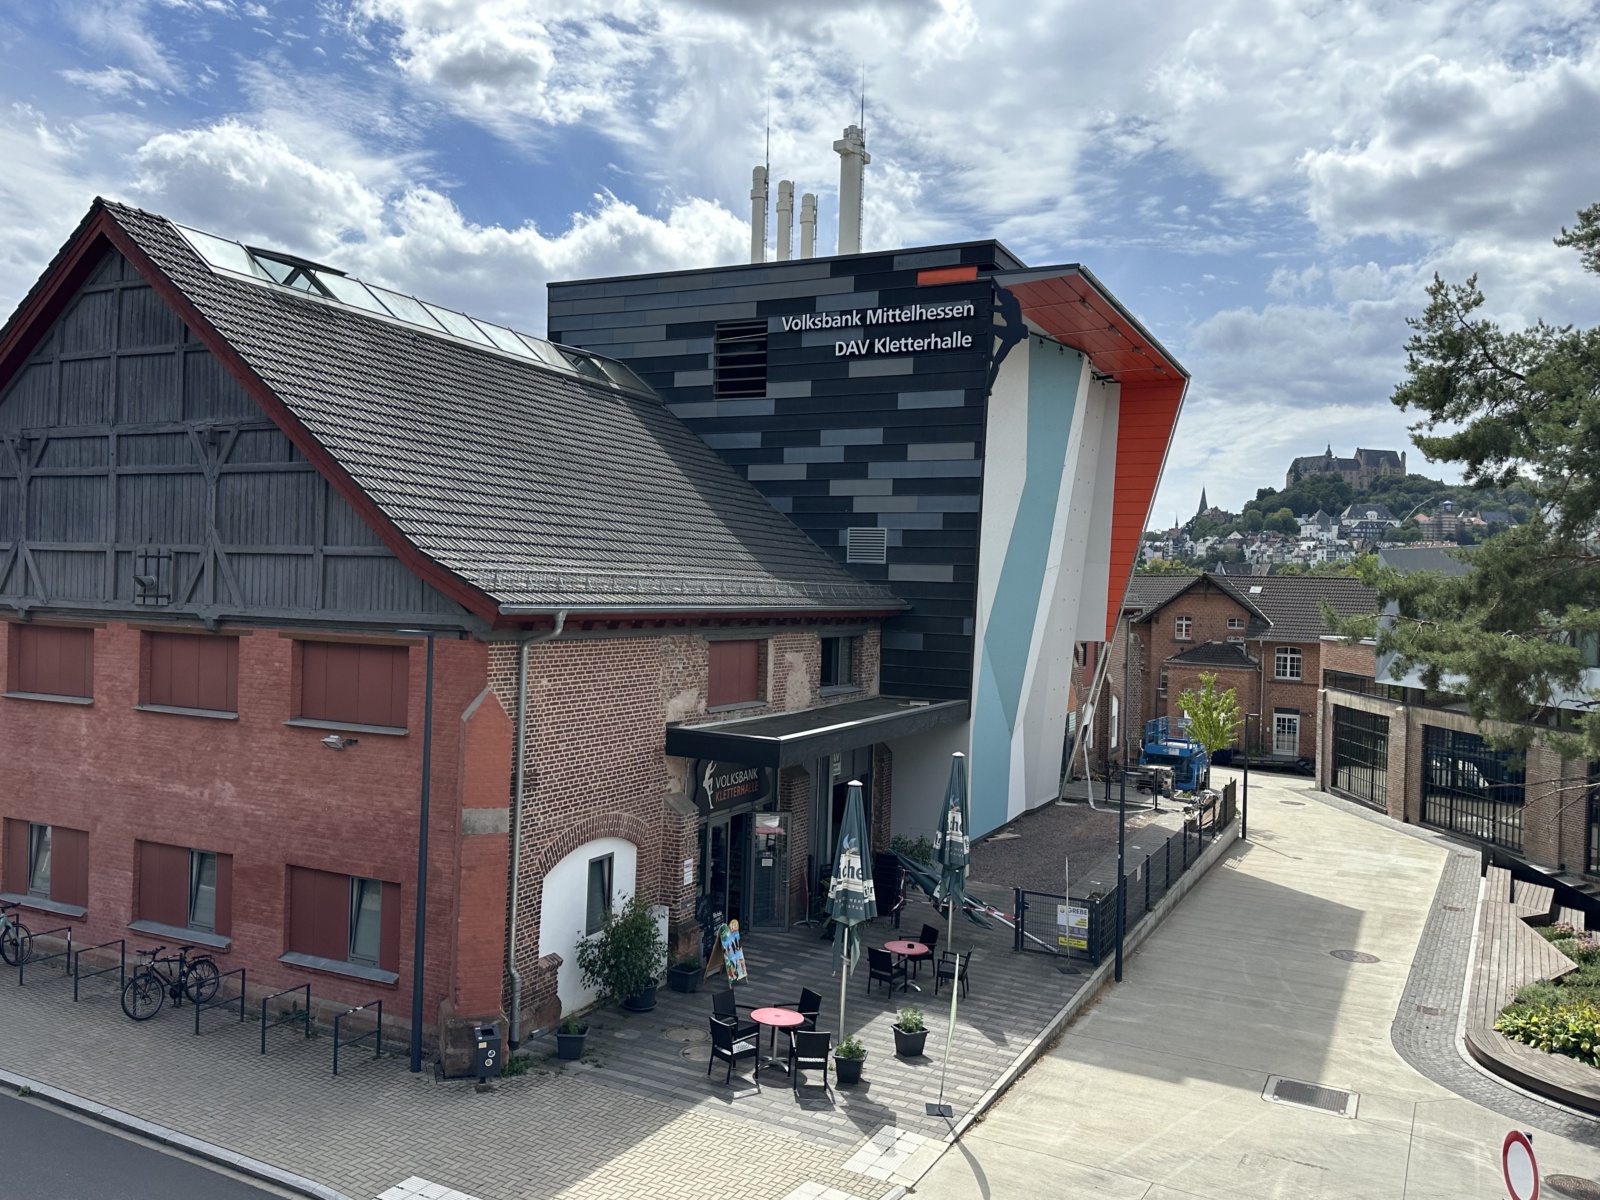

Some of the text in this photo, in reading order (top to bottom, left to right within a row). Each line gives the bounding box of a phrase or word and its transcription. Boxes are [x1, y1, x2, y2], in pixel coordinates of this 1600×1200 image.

[782, 304, 974, 331] Volksbank Mittelhessen
[835, 331, 972, 356] DAV Kletterhalle
[715, 768, 758, 788] VOLKSBANK
[715, 781, 759, 802] KLETTERHALLE
